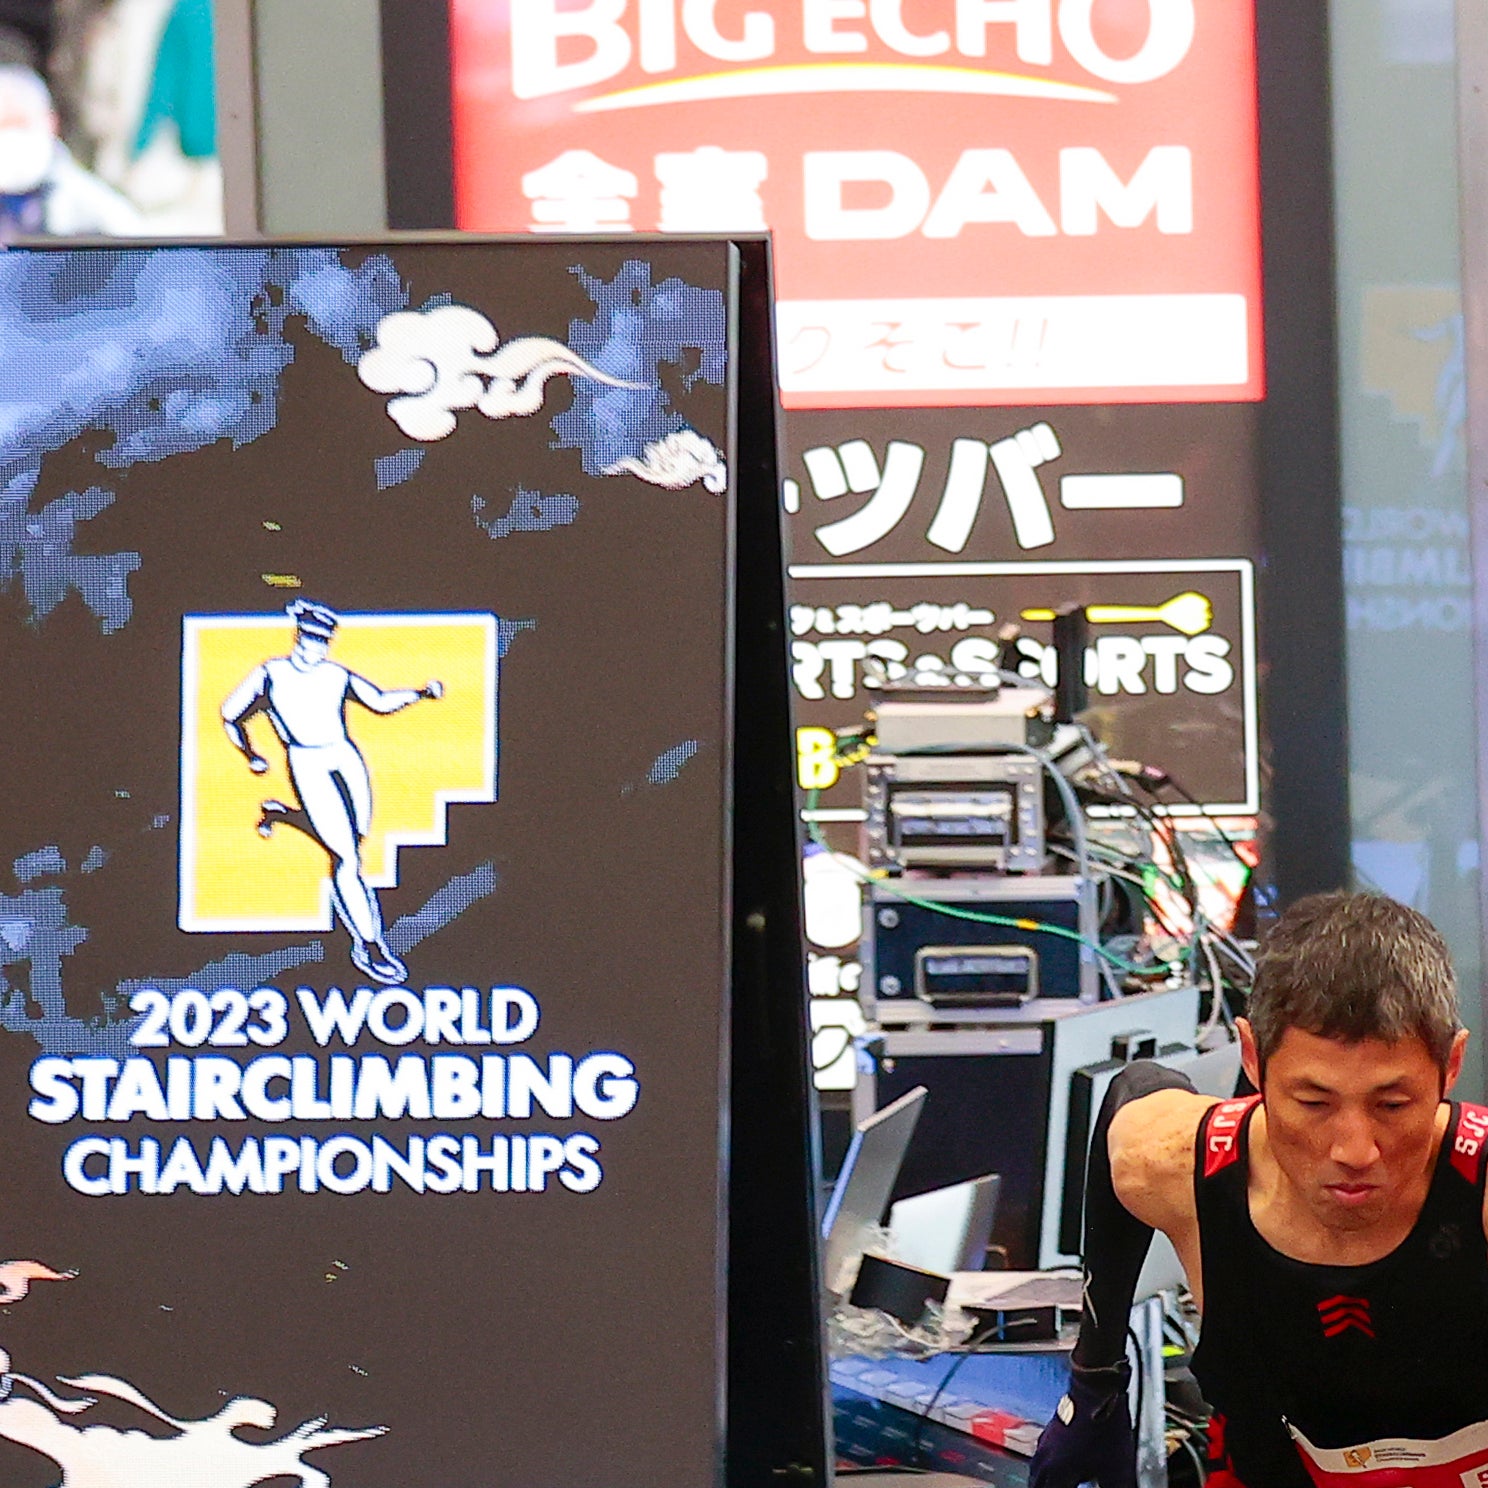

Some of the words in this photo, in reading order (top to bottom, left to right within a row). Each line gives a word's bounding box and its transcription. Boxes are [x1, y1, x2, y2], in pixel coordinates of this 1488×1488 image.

[512, 0, 775, 99] BIG
[804, 0, 1195, 84] ECHO
[803, 145, 1192, 240] DAM
[783, 420, 1185, 557] ツバー
[129, 985, 288, 1047] 2023
[295, 985, 541, 1047] WORLD
[27, 1052, 640, 1124] STAIRCLIMBING
[62, 1133, 604, 1196] CHAMPIONSHIPS
